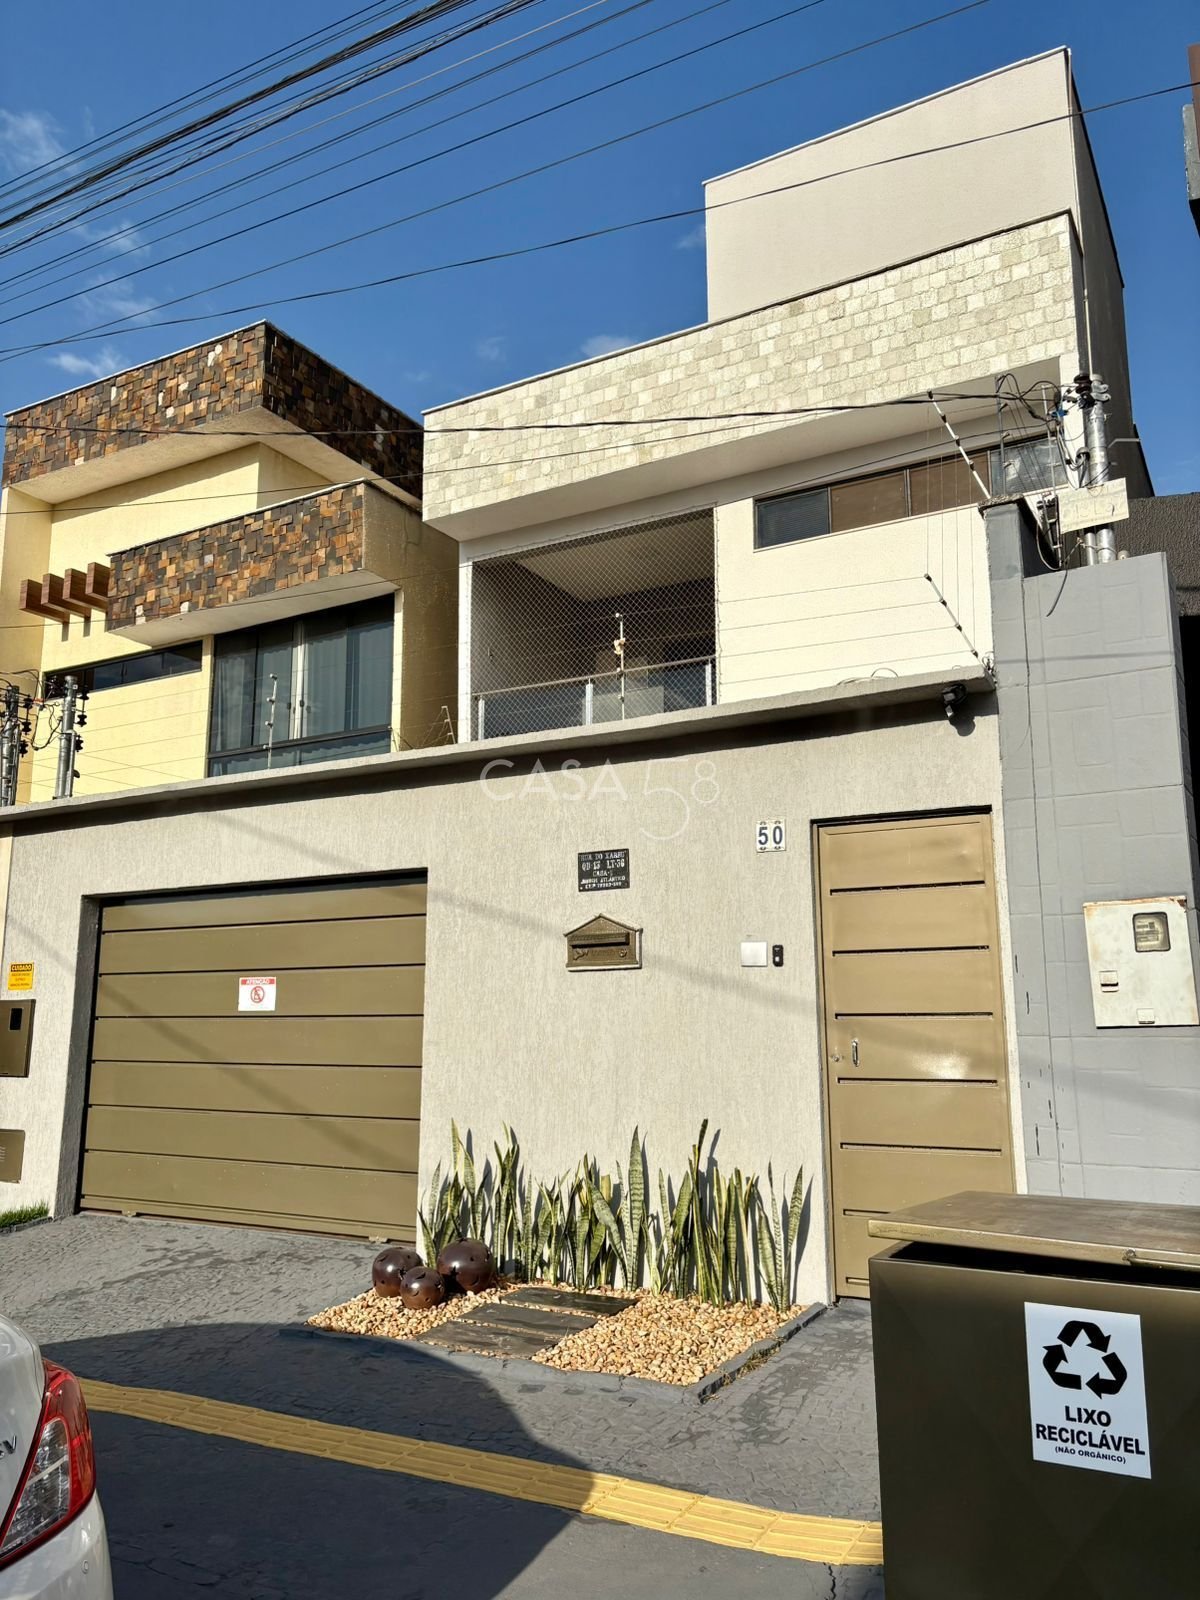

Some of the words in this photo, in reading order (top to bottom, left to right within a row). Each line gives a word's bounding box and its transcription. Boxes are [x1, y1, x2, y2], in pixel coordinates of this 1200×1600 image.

[757, 825, 783, 846] 50
[1065, 1405, 1112, 1427] LIXO
[1036, 1423, 1146, 1455] RECICLÁVEL
[1055, 1446, 1076, 1455] (NÃO
[1078, 1449, 1127, 1464] ORGÂNICO)
